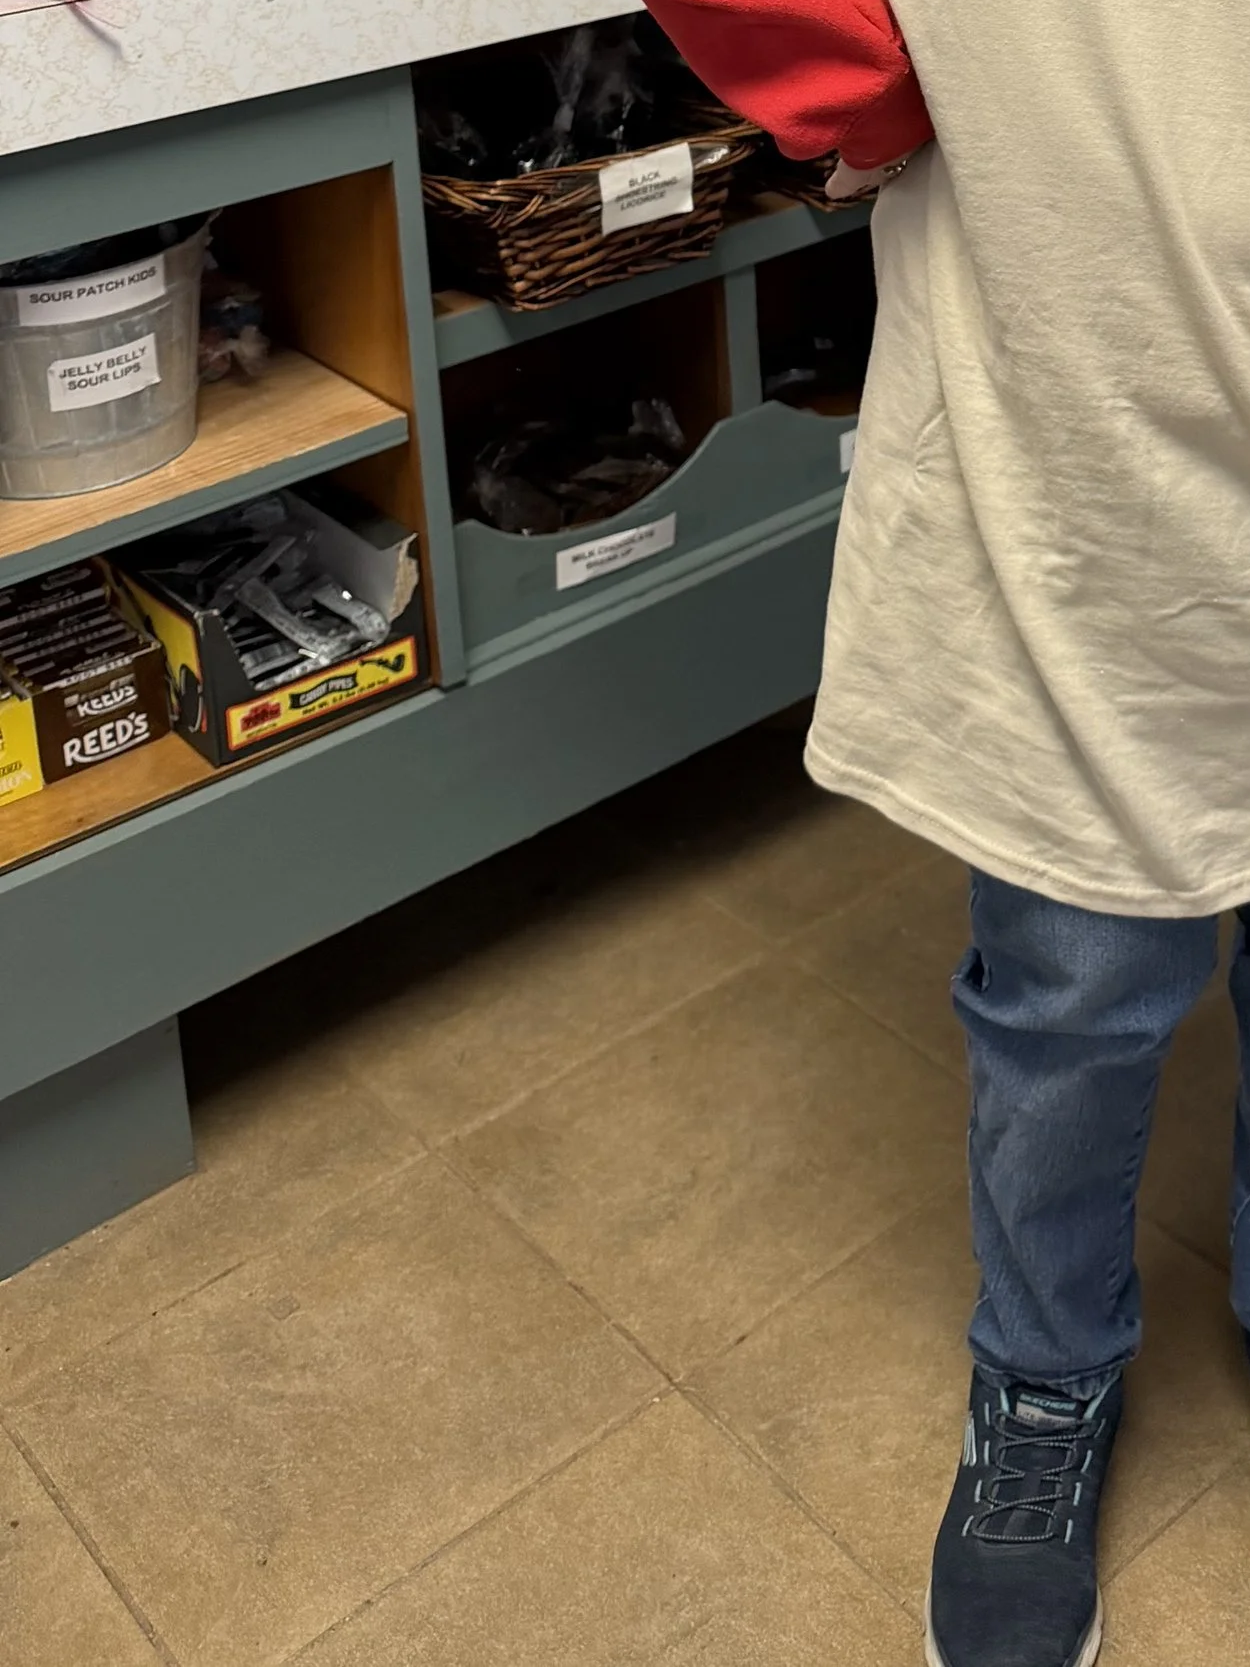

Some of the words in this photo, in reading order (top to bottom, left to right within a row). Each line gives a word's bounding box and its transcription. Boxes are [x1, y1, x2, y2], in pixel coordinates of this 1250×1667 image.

[29, 290, 73, 304] SOUR
[77, 278, 125, 298] PATCH
[127, 266, 157, 286] KIDS
[59, 362, 103, 379] JELLY
[106, 346, 147, 368] BELLY
[68, 373, 109, 391] SOUR
[112, 362, 141, 381] LIPS
[62, 712, 150, 767] REED'S
